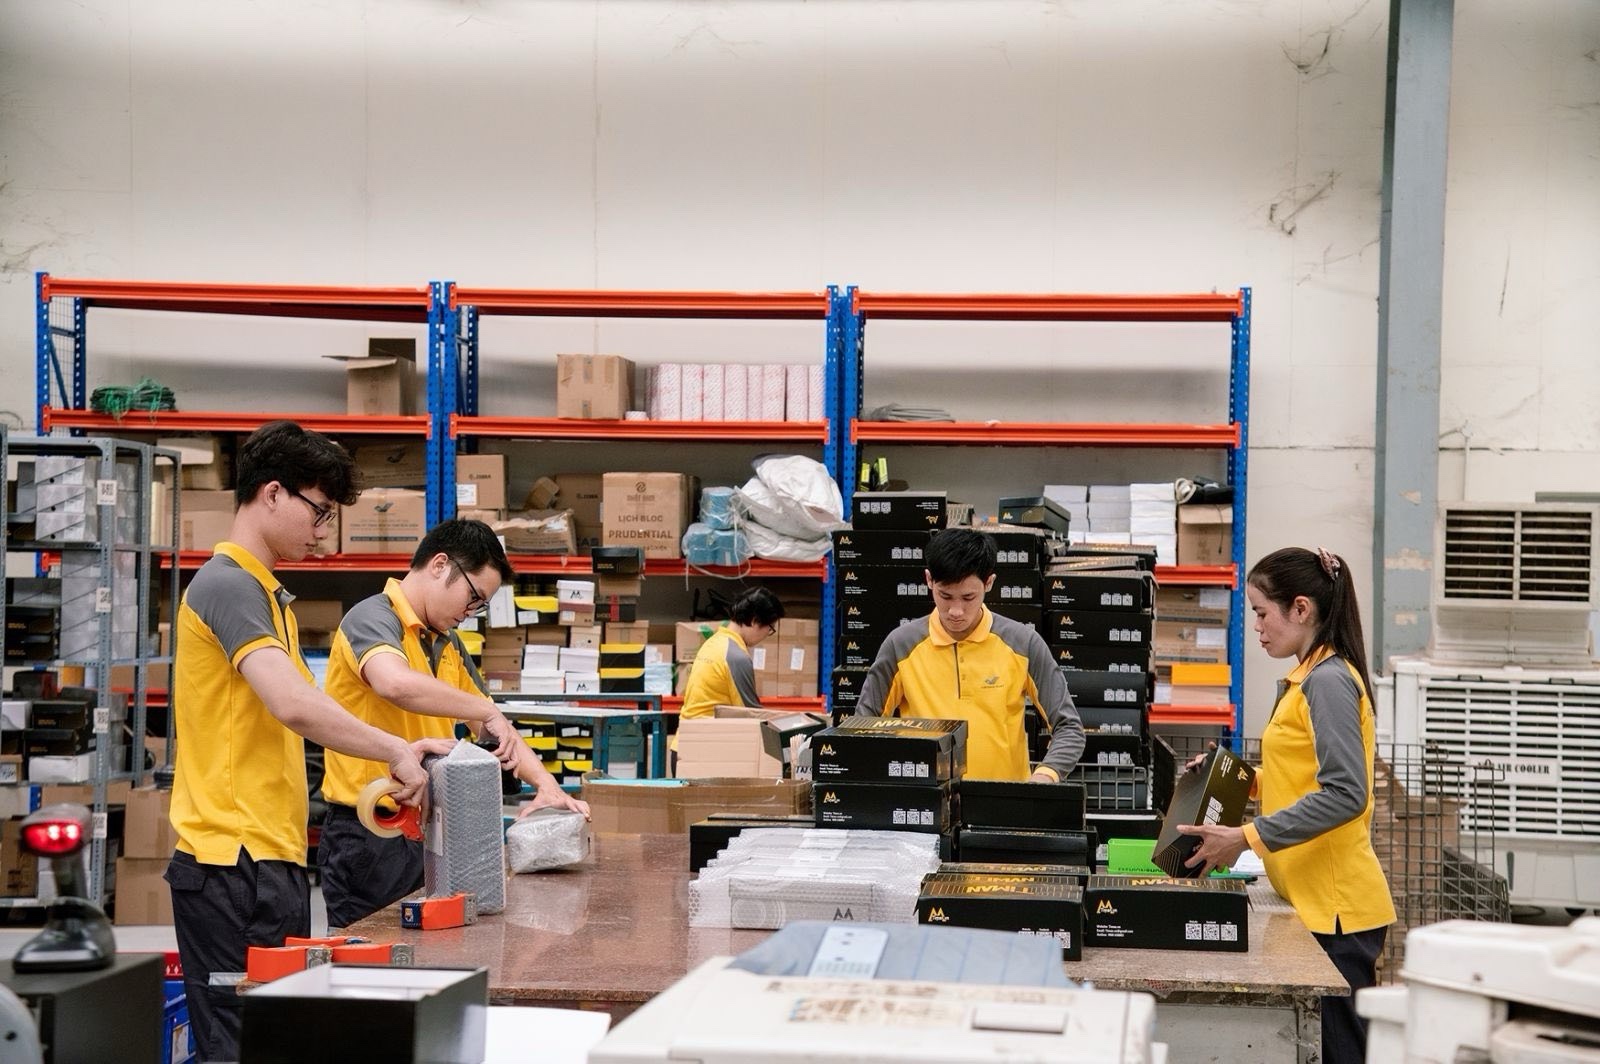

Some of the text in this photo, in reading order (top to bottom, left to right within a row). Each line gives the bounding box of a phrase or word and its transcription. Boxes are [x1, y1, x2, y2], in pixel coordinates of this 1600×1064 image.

[640, 514, 663, 523] BLOC
[608, 529, 673, 539] PRUDENTIAL
[1514, 764, 1550, 774] COOLER
[966, 885, 1035, 895] TIMAN
